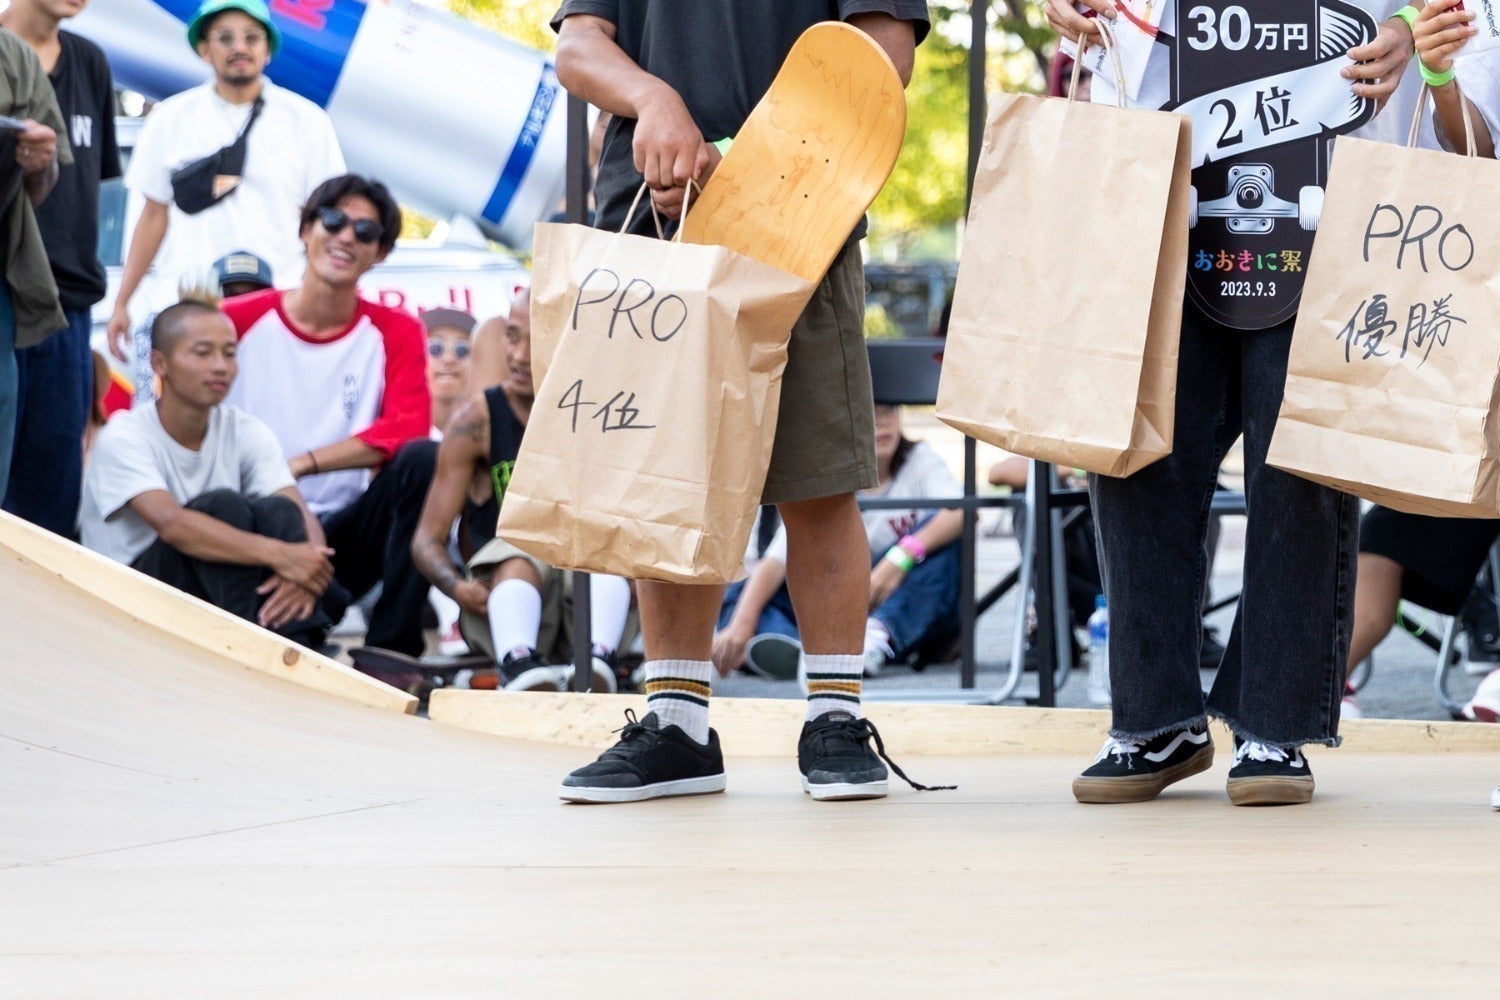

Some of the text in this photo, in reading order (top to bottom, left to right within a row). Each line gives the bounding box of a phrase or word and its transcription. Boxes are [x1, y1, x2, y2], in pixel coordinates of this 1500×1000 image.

[1186, 5, 1309, 52] 30万円
[1208, 85, 1300, 149] 2位
[1194, 249, 1302, 273] おおきに祭
[1363, 203, 1475, 274] PRO
[571, 268, 687, 343] PRO
[1220, 281, 1277, 297] 2023.9.3
[1336, 293, 1467, 369] 優勝
